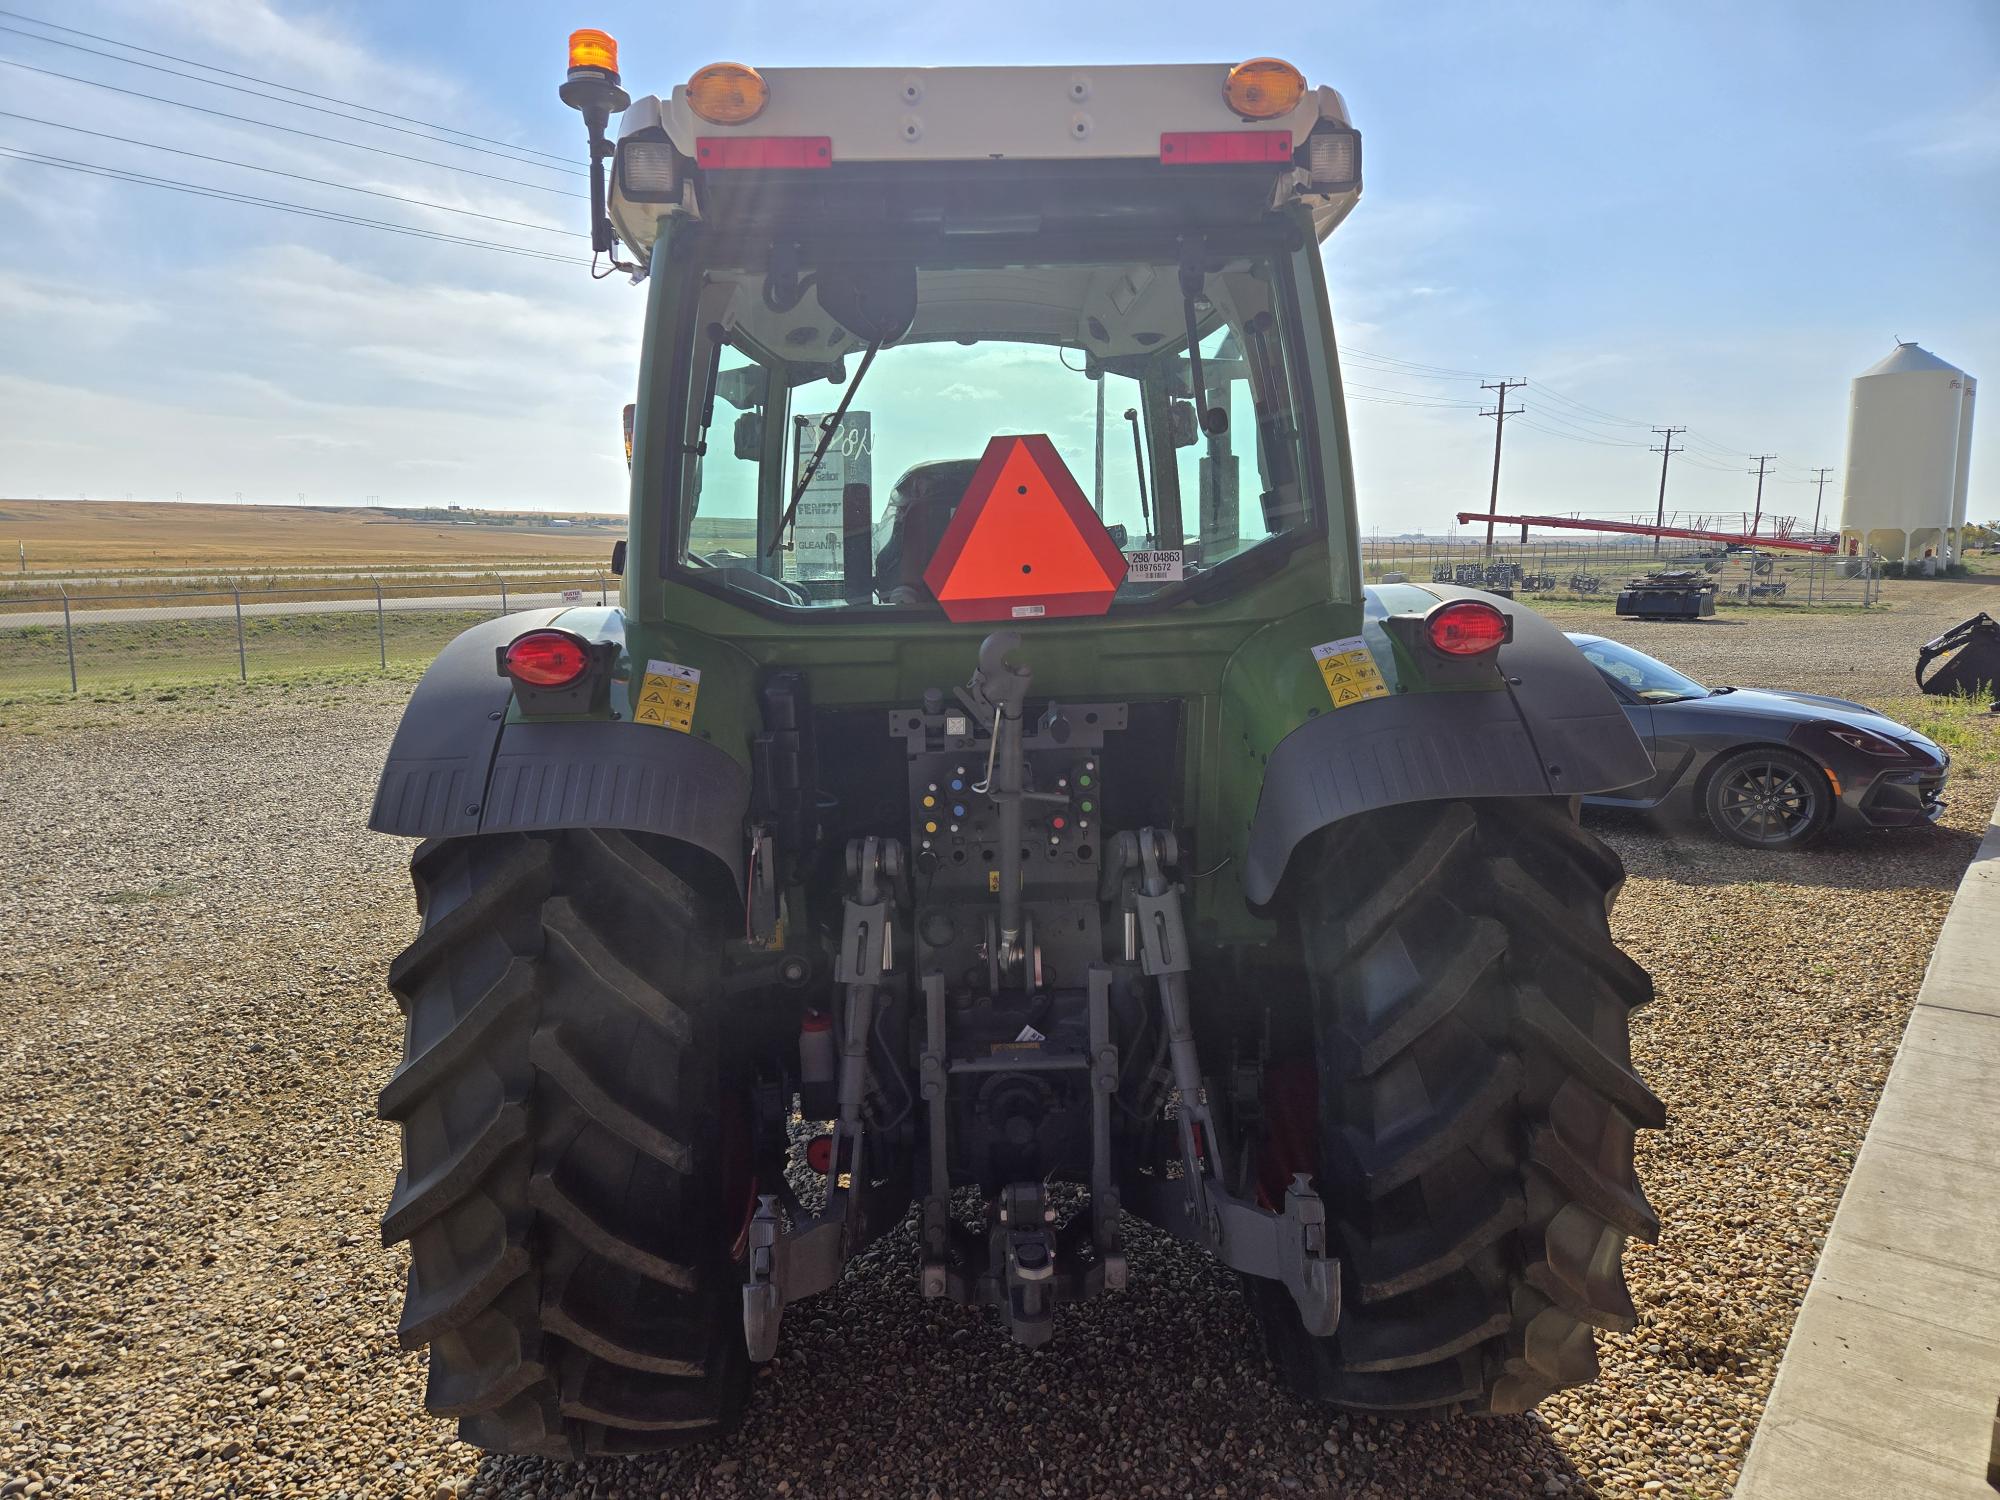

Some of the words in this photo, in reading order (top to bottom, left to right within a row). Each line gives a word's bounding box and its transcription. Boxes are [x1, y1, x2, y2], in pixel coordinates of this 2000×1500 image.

[797, 502, 842, 515] FENDT
[798, 541, 842, 550] GLEANR
[1153, 551, 1180, 563] 04863
[1131, 562, 1172, 572] 118976572
